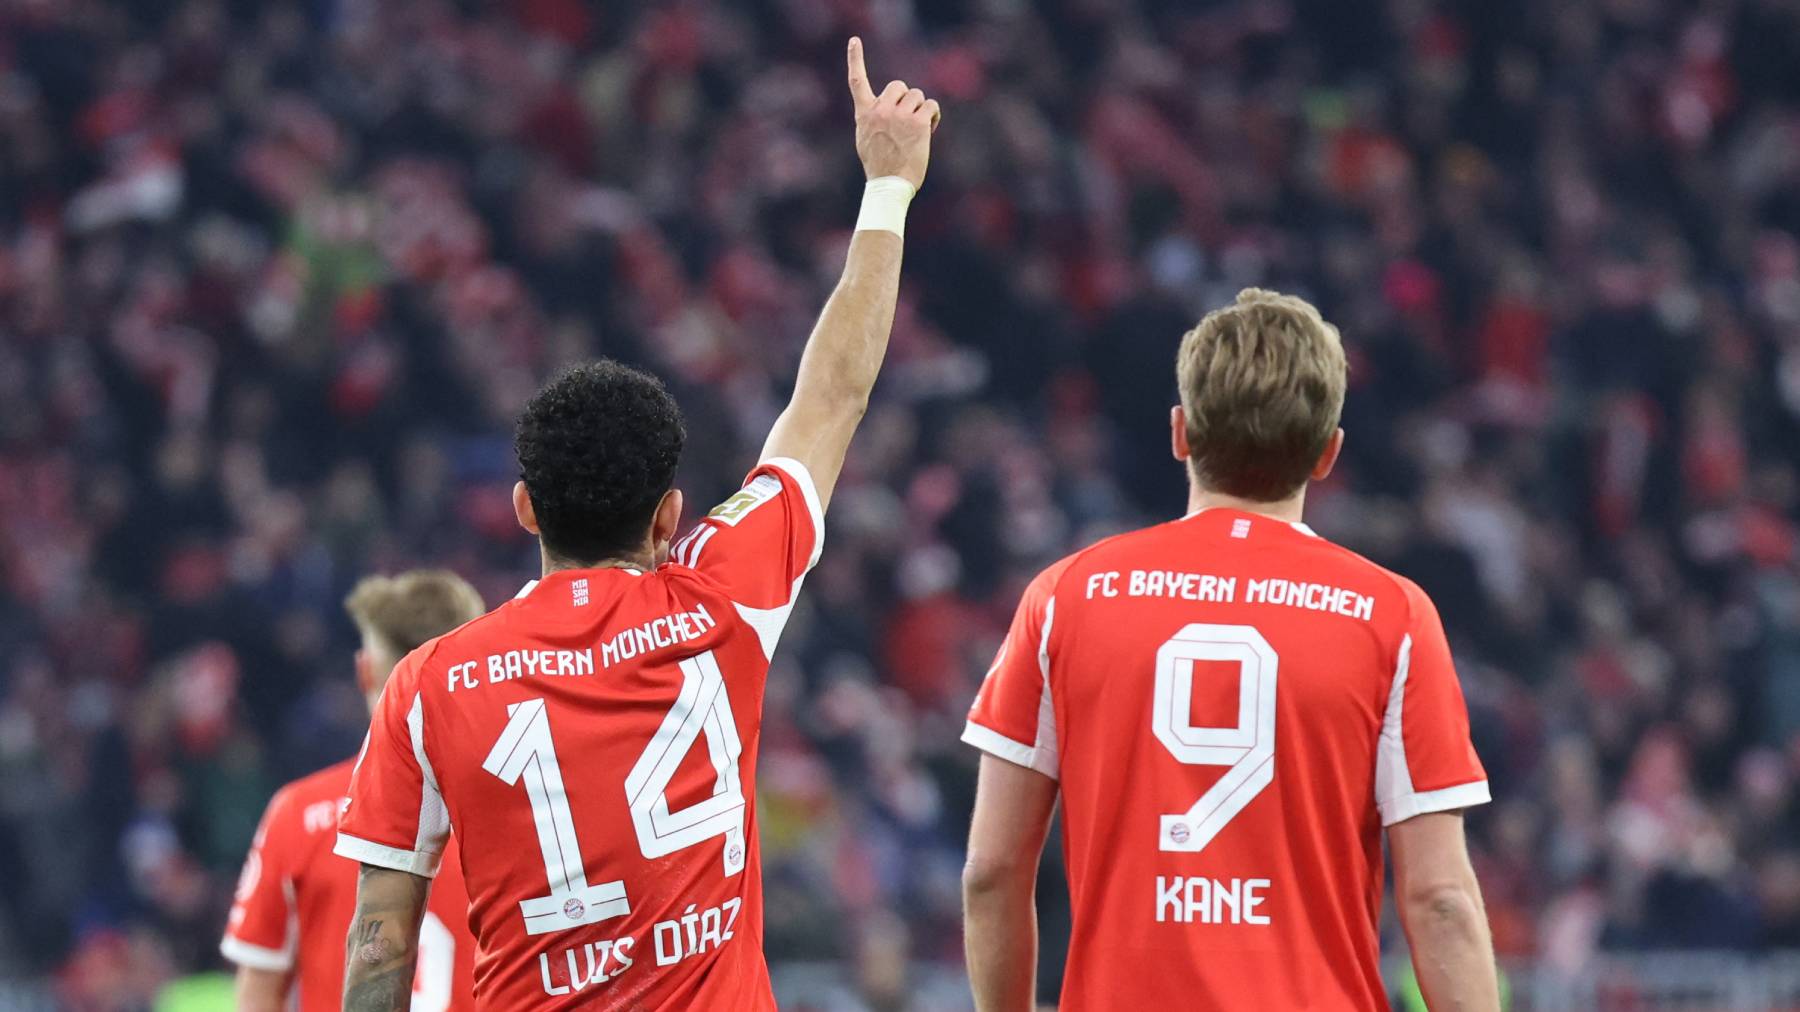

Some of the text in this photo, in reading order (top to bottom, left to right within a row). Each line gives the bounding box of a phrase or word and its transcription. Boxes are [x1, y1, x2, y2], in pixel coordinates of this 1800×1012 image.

[1086, 570, 1375, 621] FC BAYERN MÜNCHEN
[447, 603, 716, 692] FC BAYERN MÜNCHEN
[1152, 623, 1279, 852] 9
[481, 649, 745, 936] 14
[538, 896, 742, 996] LUIS DÍAZ
[1156, 876, 1271, 925] KANE
